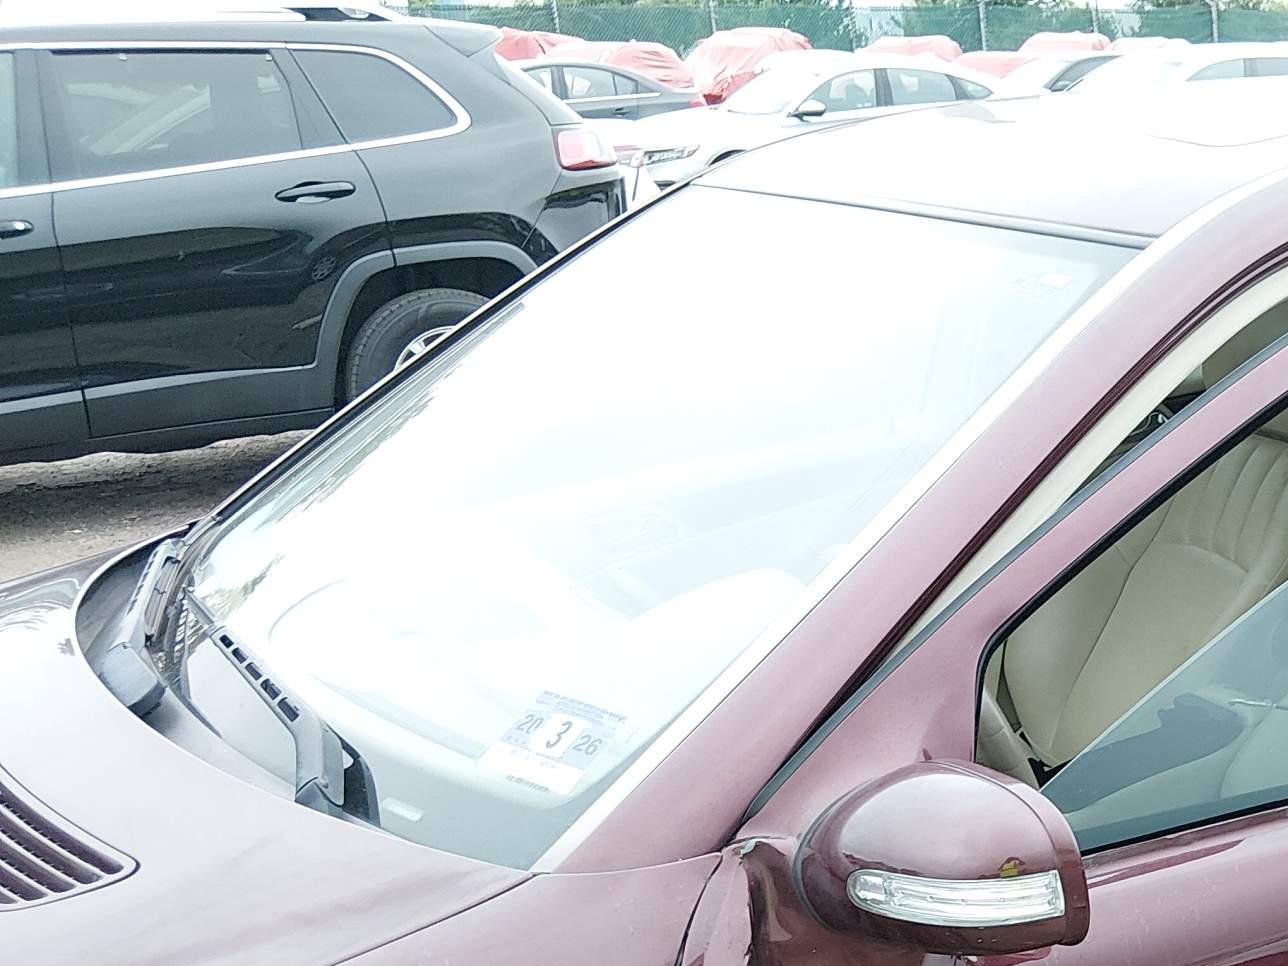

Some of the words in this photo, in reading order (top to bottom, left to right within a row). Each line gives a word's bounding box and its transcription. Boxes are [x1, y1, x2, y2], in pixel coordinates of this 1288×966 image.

[514, 713, 545, 735] 20
[545, 720, 574, 749] 3
[571, 733, 603, 756] 26
